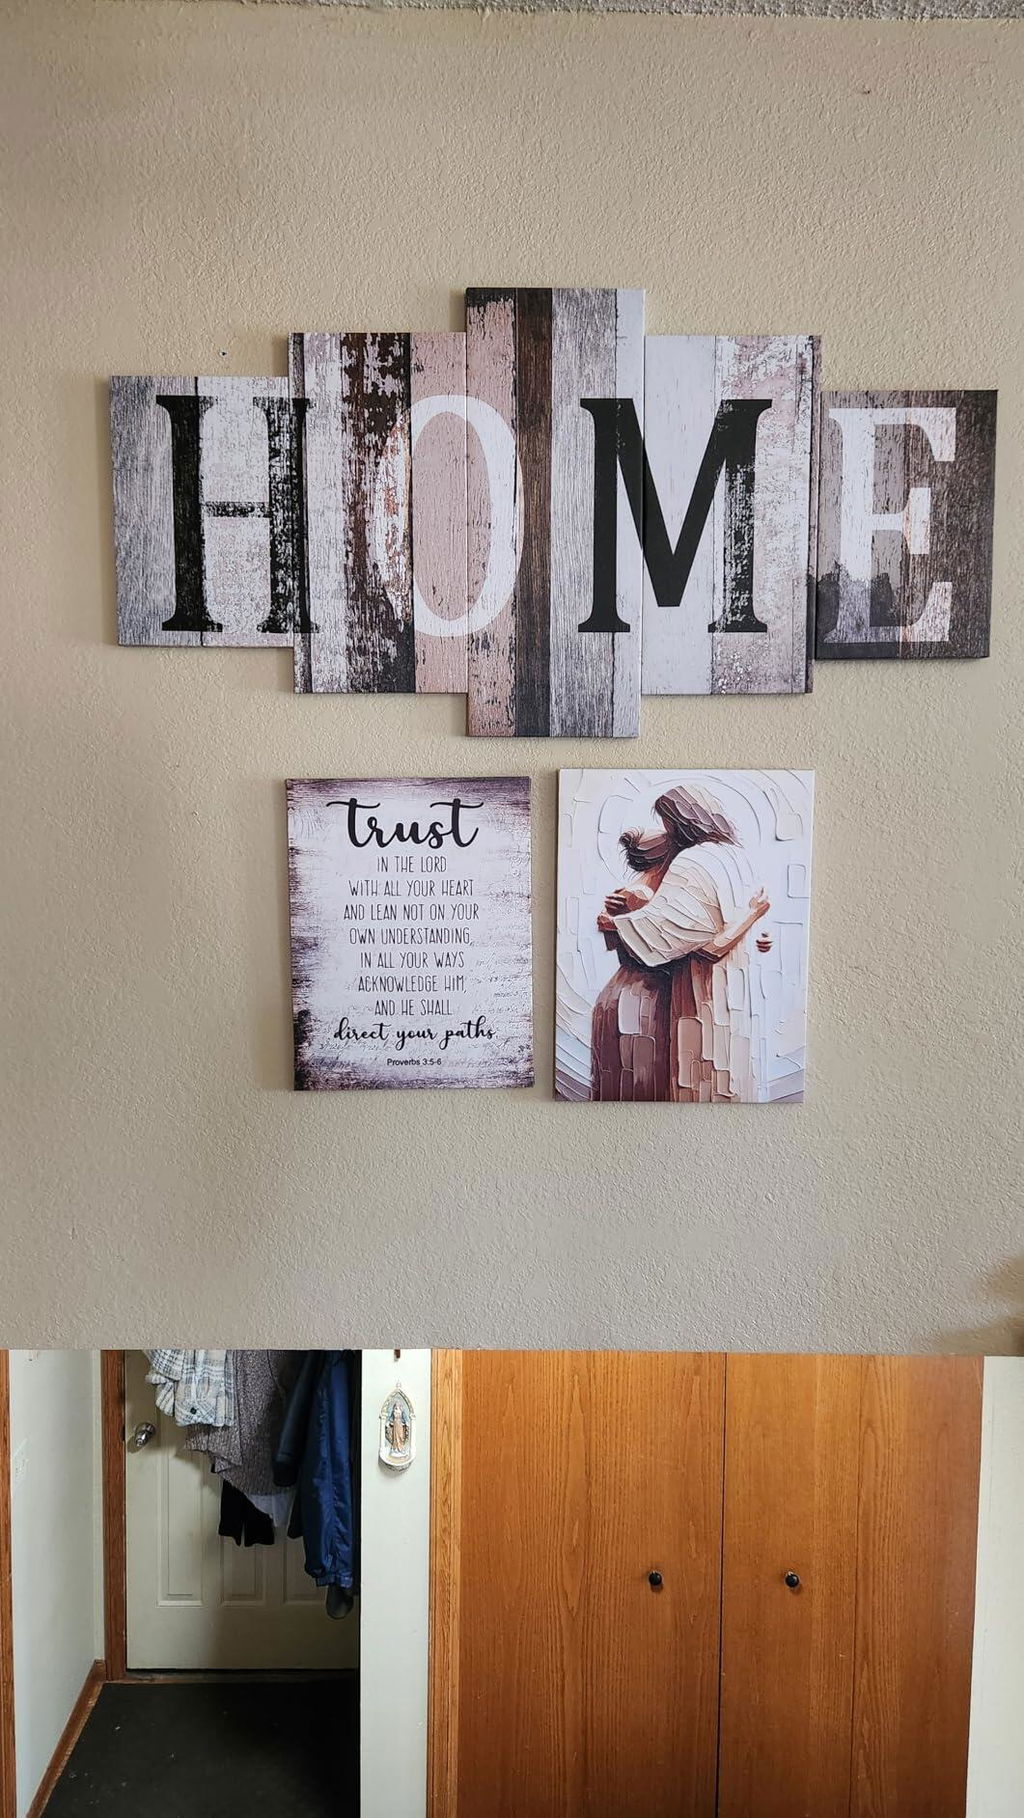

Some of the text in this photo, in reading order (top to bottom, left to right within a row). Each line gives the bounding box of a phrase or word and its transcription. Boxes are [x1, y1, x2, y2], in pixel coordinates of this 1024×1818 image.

[155, 392, 958, 643] HOME
[326, 798, 484, 848] trust
[377, 855, 447, 873] IN THE LORD
[348, 879, 474, 897] WITH ALL YOUR HEART
[343, 902, 480, 921] AND LEAN NOT ON YOUR
[349, 927, 376, 945] OWN
[360, 951, 465, 969] IN ALL YOUR WAYS
[358, 974, 468, 994] ACKNOWLEDGE HIM,
[374, 999, 453, 1017] AND HE SHALL
[333, 1015, 497, 1051] direct your paths
[386, 1057, 421, 1067] Proverbs
